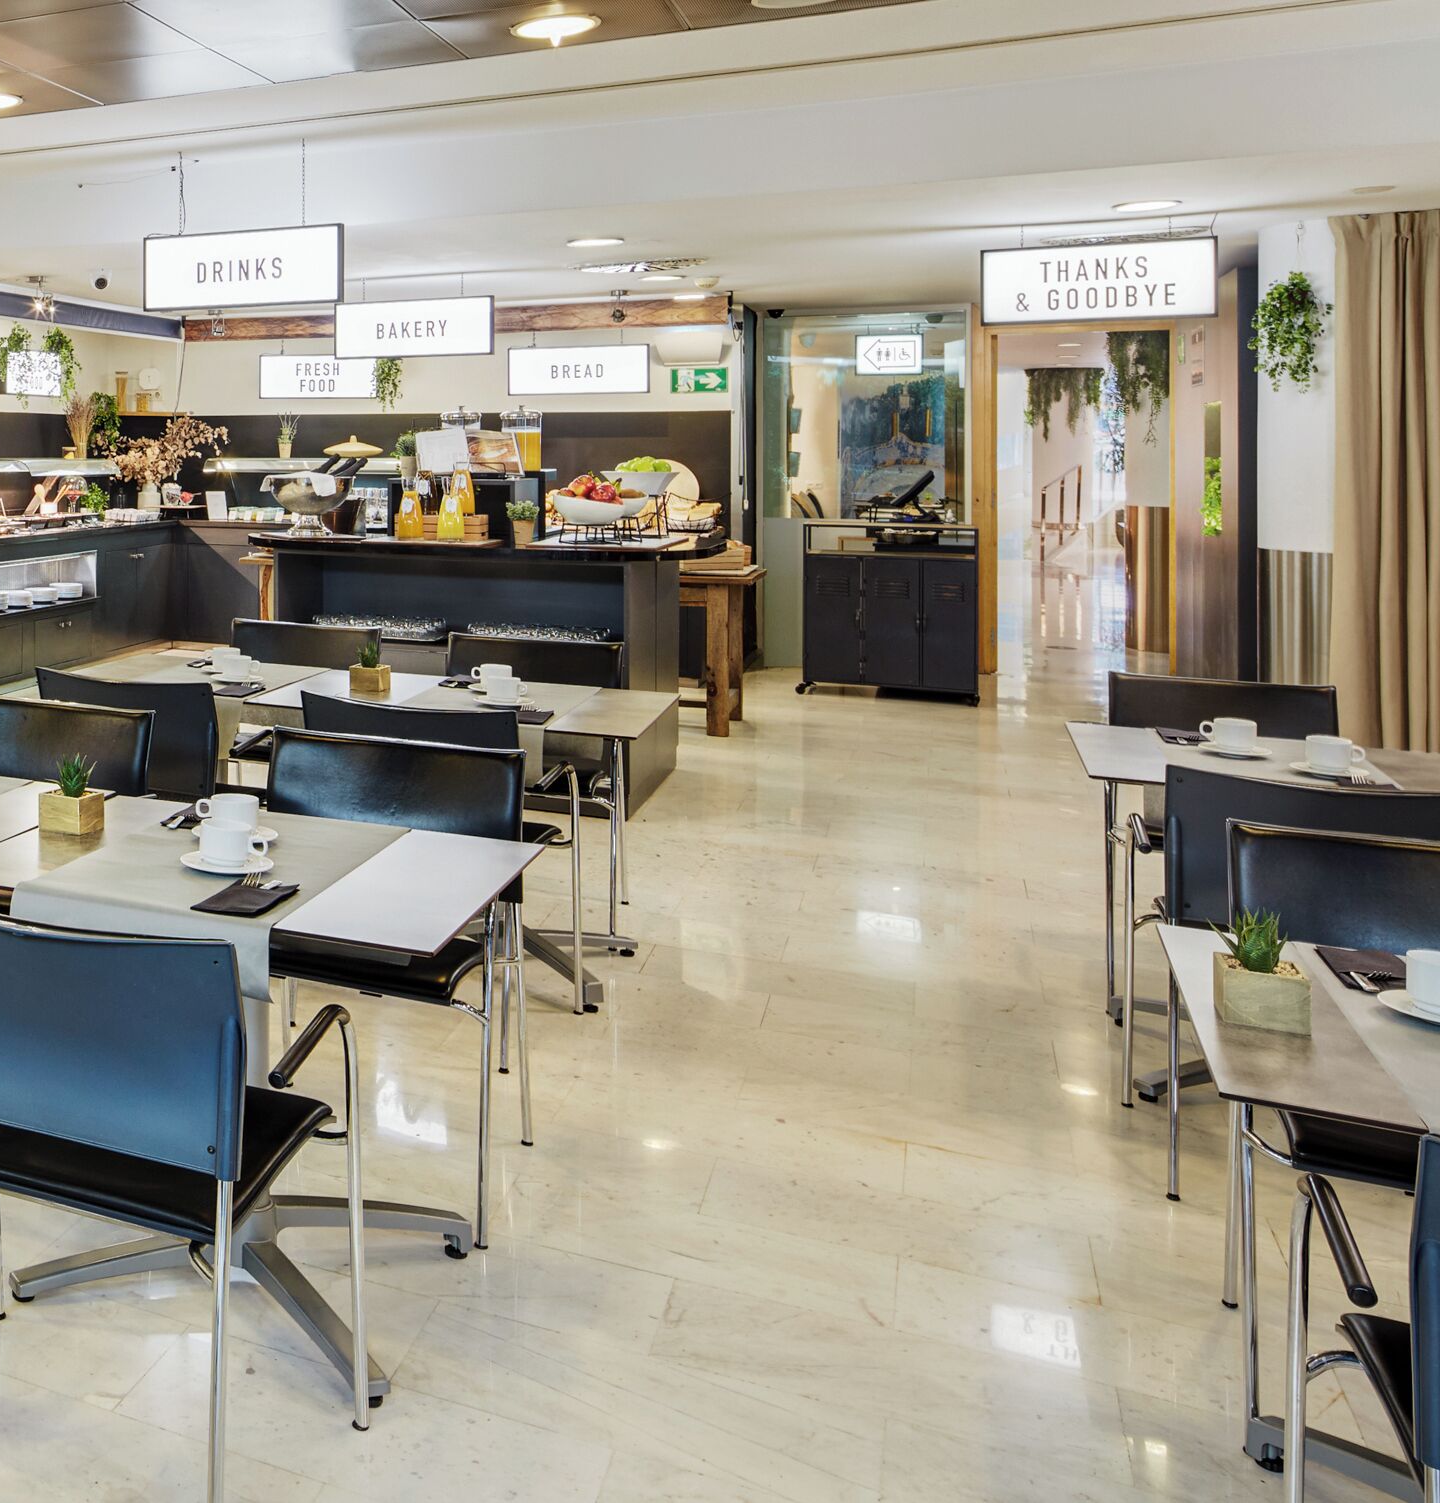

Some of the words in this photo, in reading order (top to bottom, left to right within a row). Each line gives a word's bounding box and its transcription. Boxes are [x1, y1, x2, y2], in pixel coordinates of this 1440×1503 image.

[197, 257, 283, 284] DRINKS
[1039, 255, 1148, 283] THANKS
[1016, 292, 1030, 312] &
[1047, 283, 1176, 311] GOODBYE
[376, 319, 448, 340] BAKERY
[295, 362, 341, 377] FRESH
[550, 363, 604, 379] BREAD
[299, 379, 336, 393] FOOD
